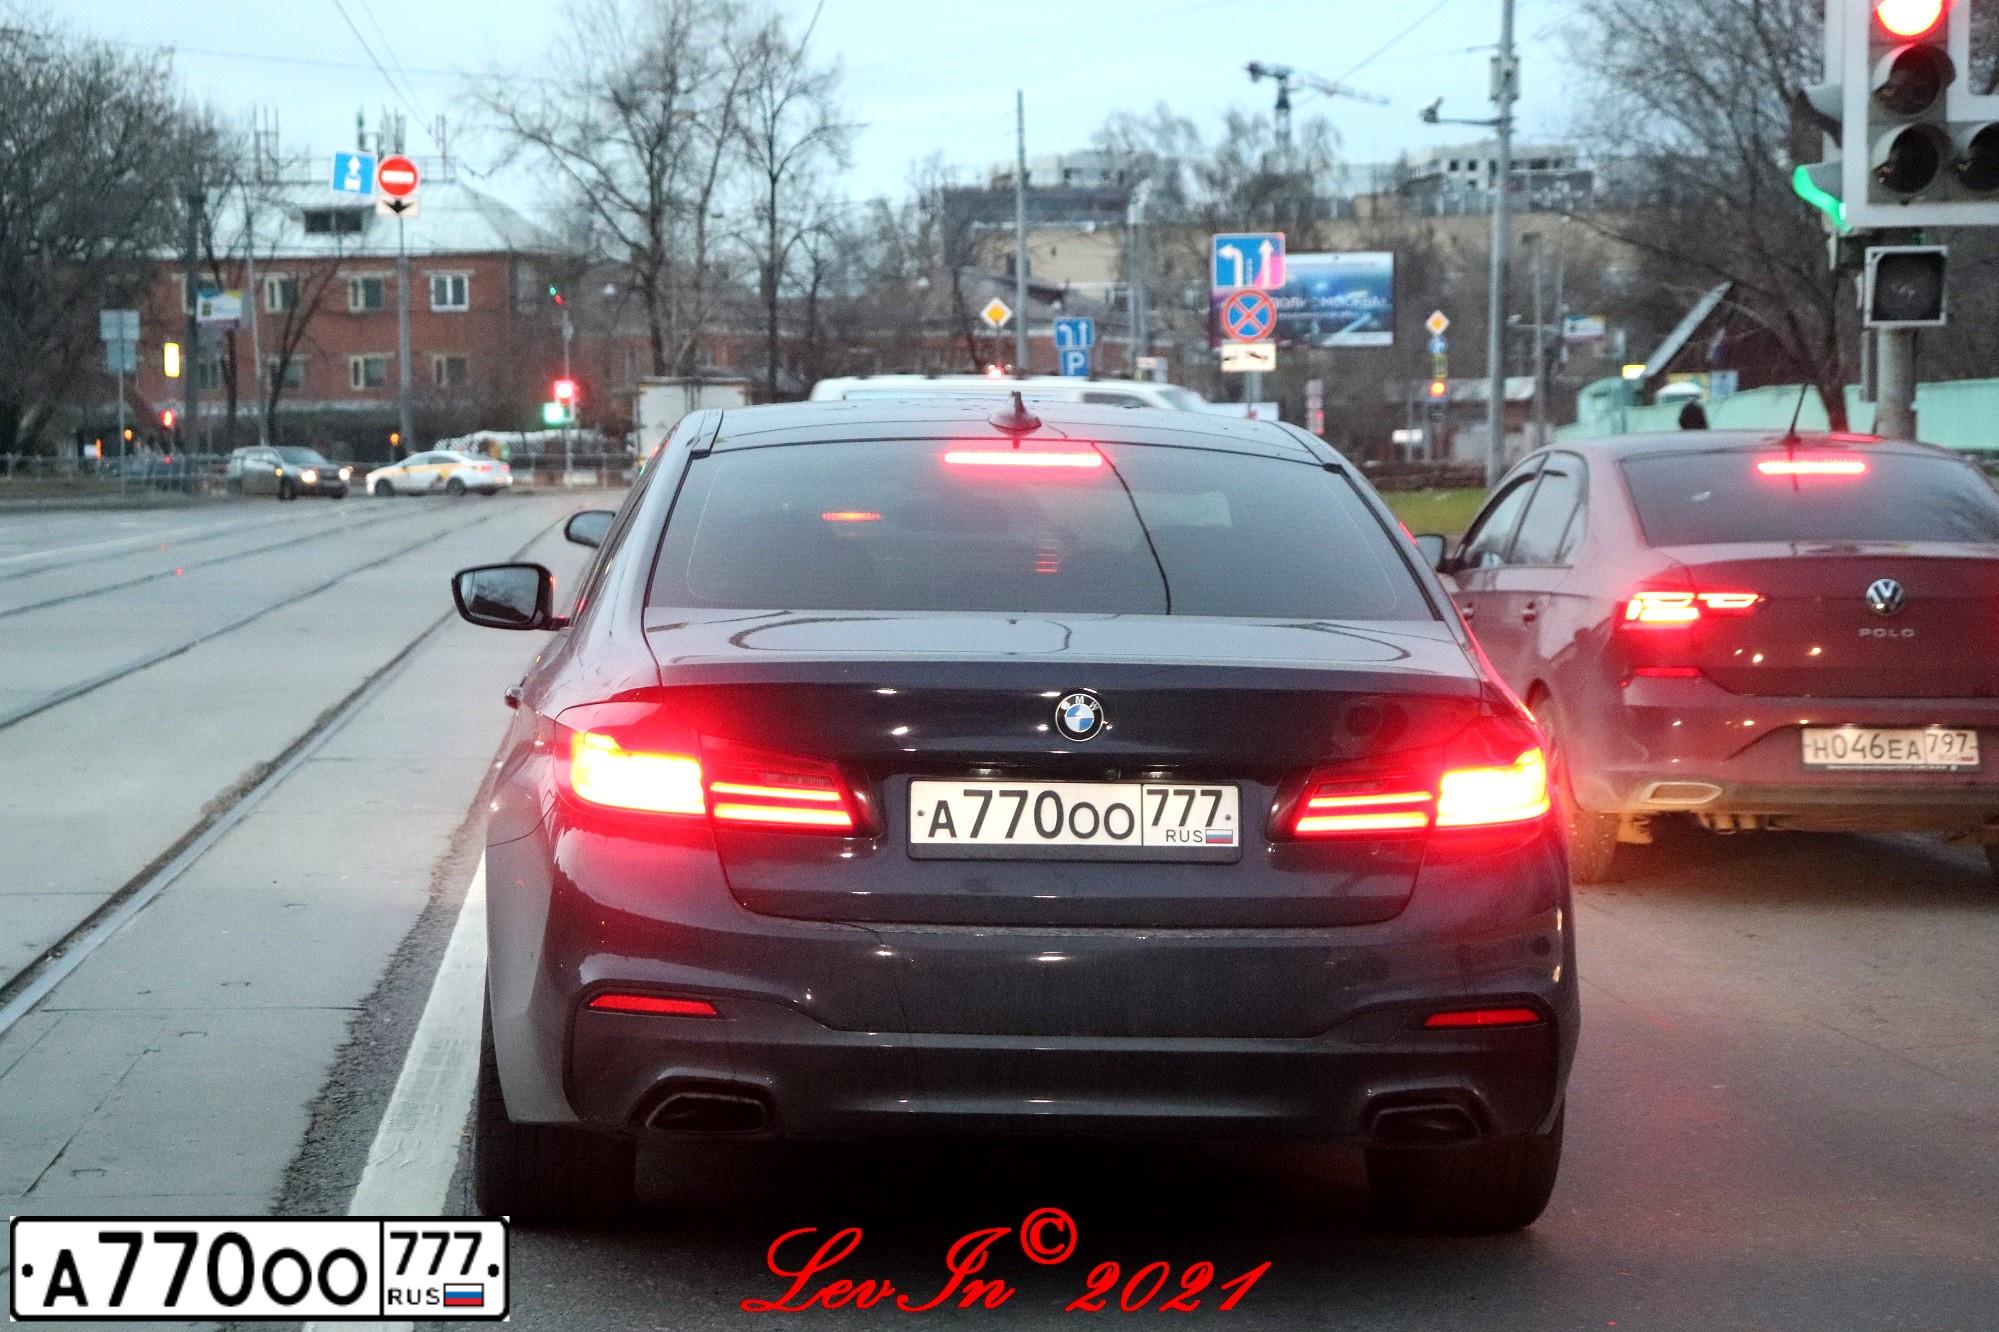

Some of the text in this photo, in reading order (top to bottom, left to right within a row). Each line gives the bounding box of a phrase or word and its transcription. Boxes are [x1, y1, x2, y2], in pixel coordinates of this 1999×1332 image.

[1067, 352, 1085, 376] P
[1858, 628, 1915, 637] POLO
[1926, 733, 1969, 753] 797
[1147, 789, 1223, 828] 777
[1166, 830, 1203, 843] RUS
